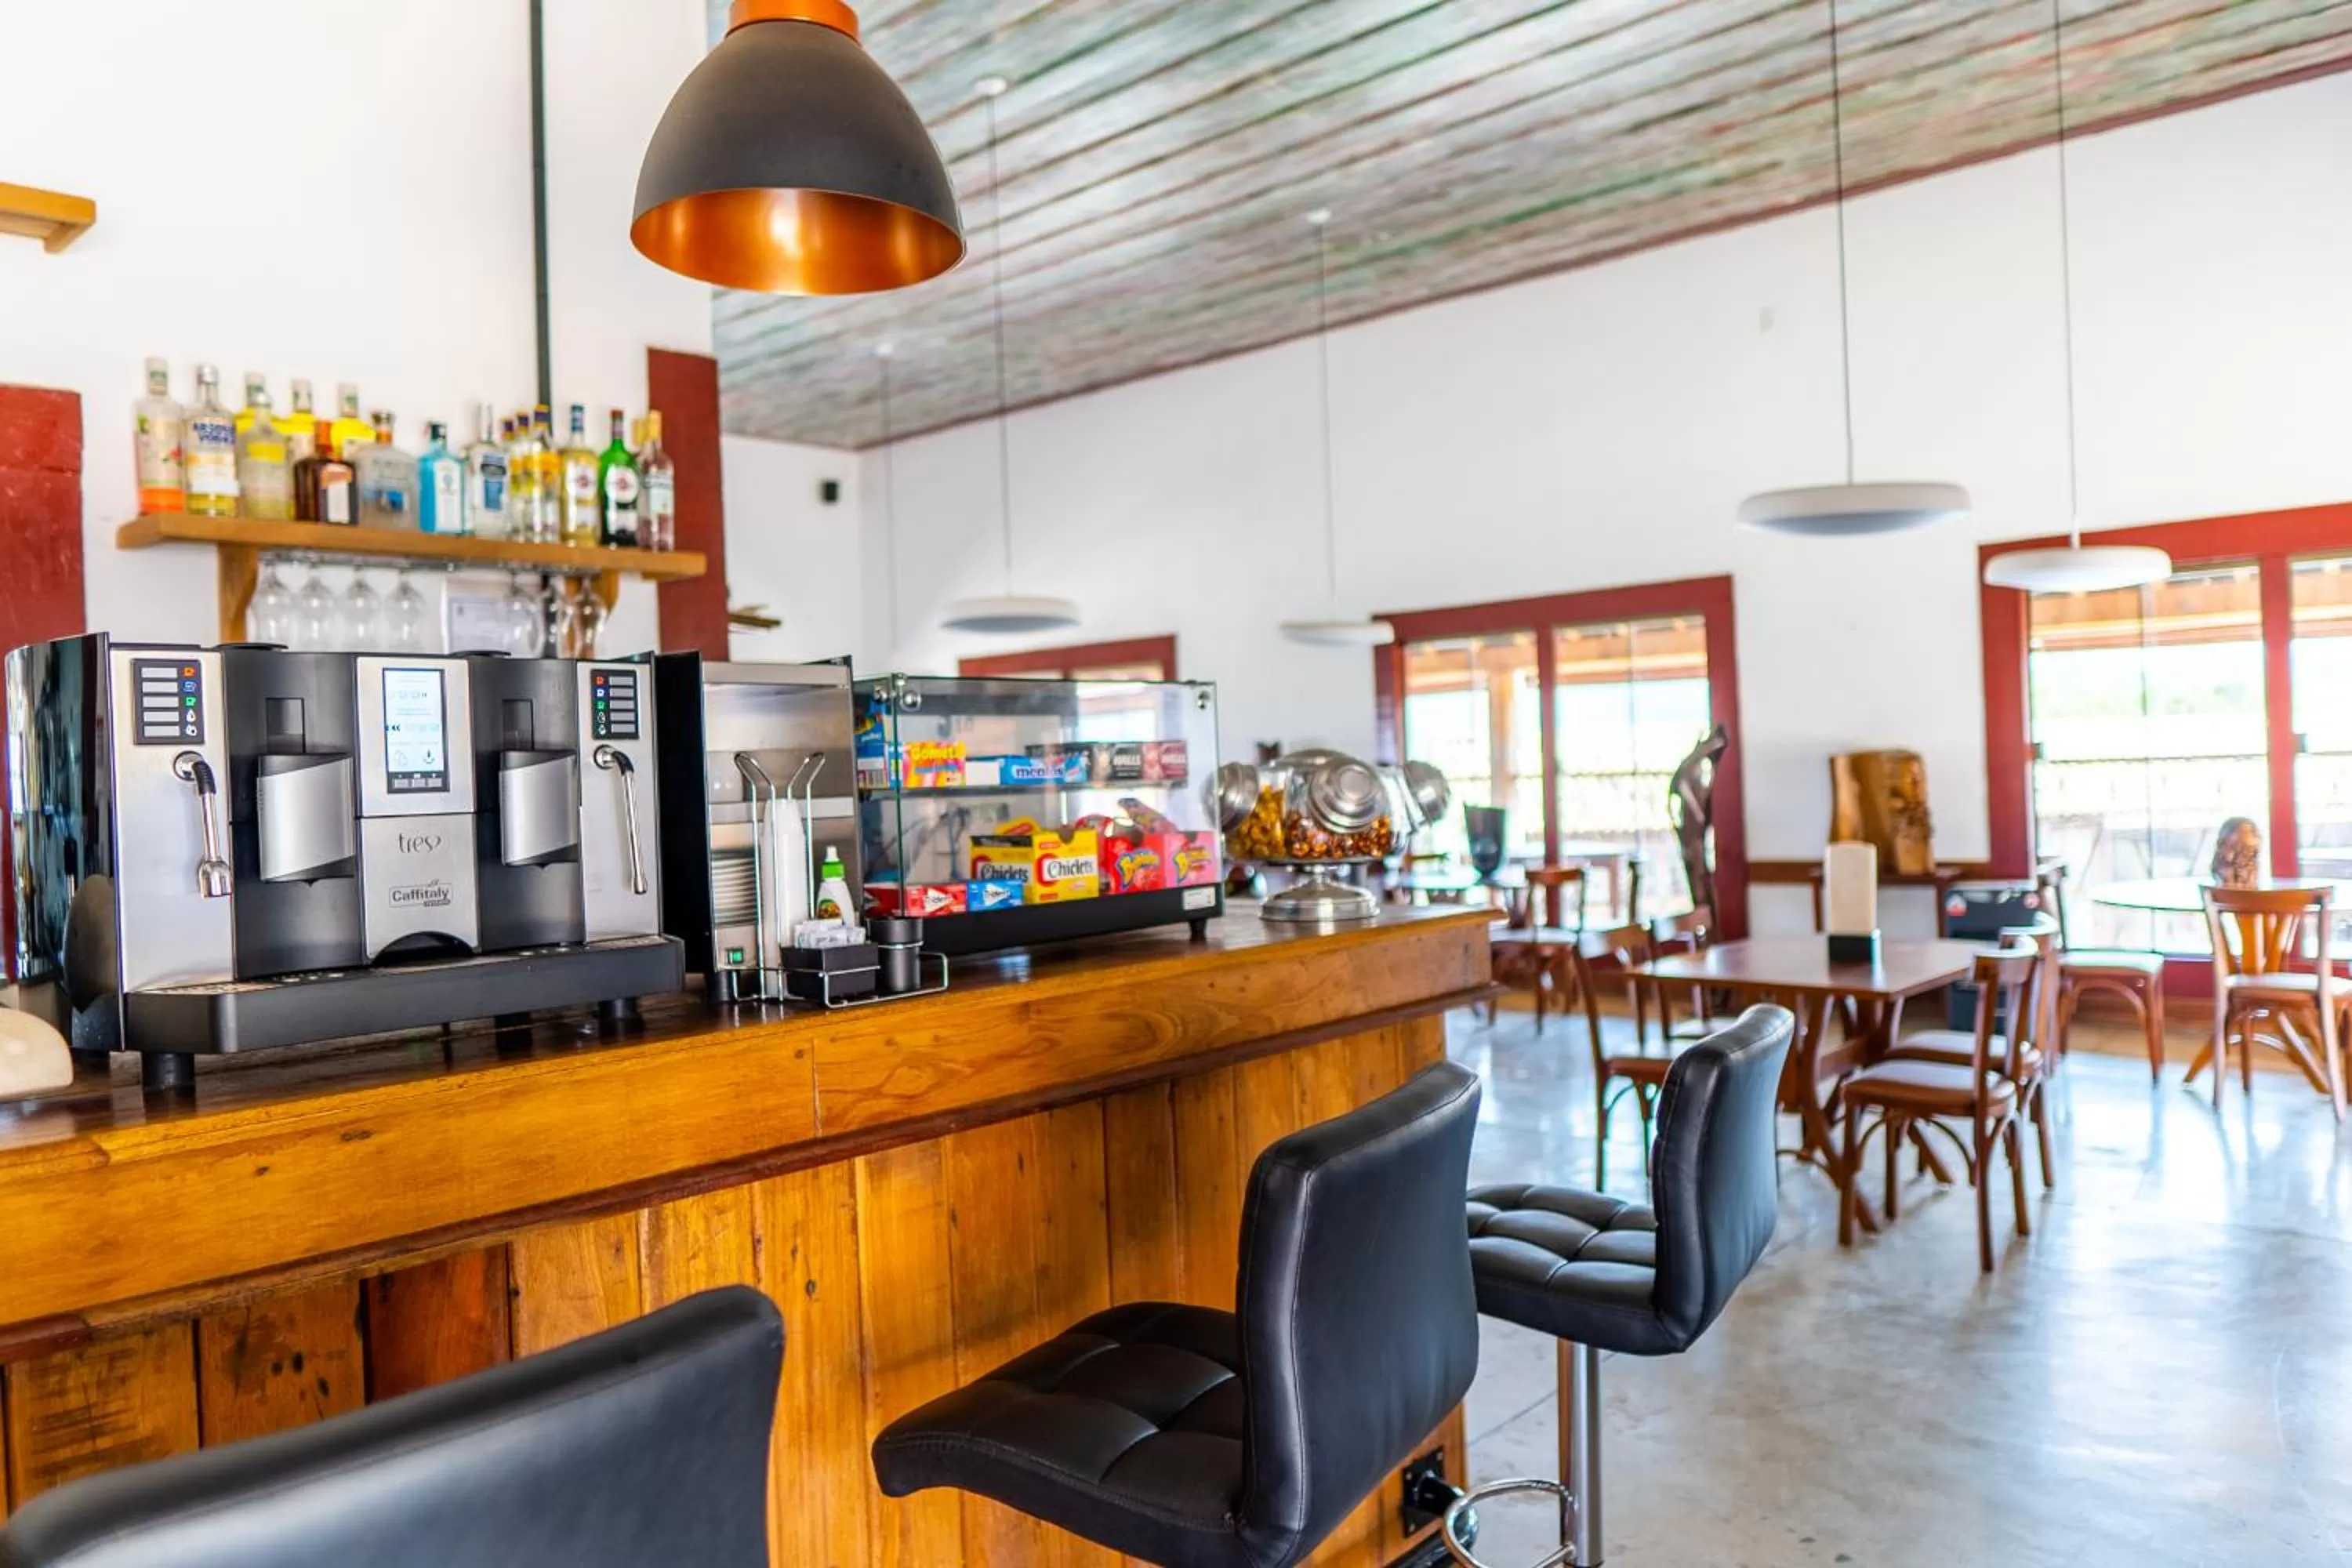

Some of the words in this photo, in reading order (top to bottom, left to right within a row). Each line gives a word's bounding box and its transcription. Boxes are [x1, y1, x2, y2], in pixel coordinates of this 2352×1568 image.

[980, 864, 1029, 884] Chiclets
[1047, 858, 1095, 880] Chiclets
[392, 887, 449, 902] Caffitaly
